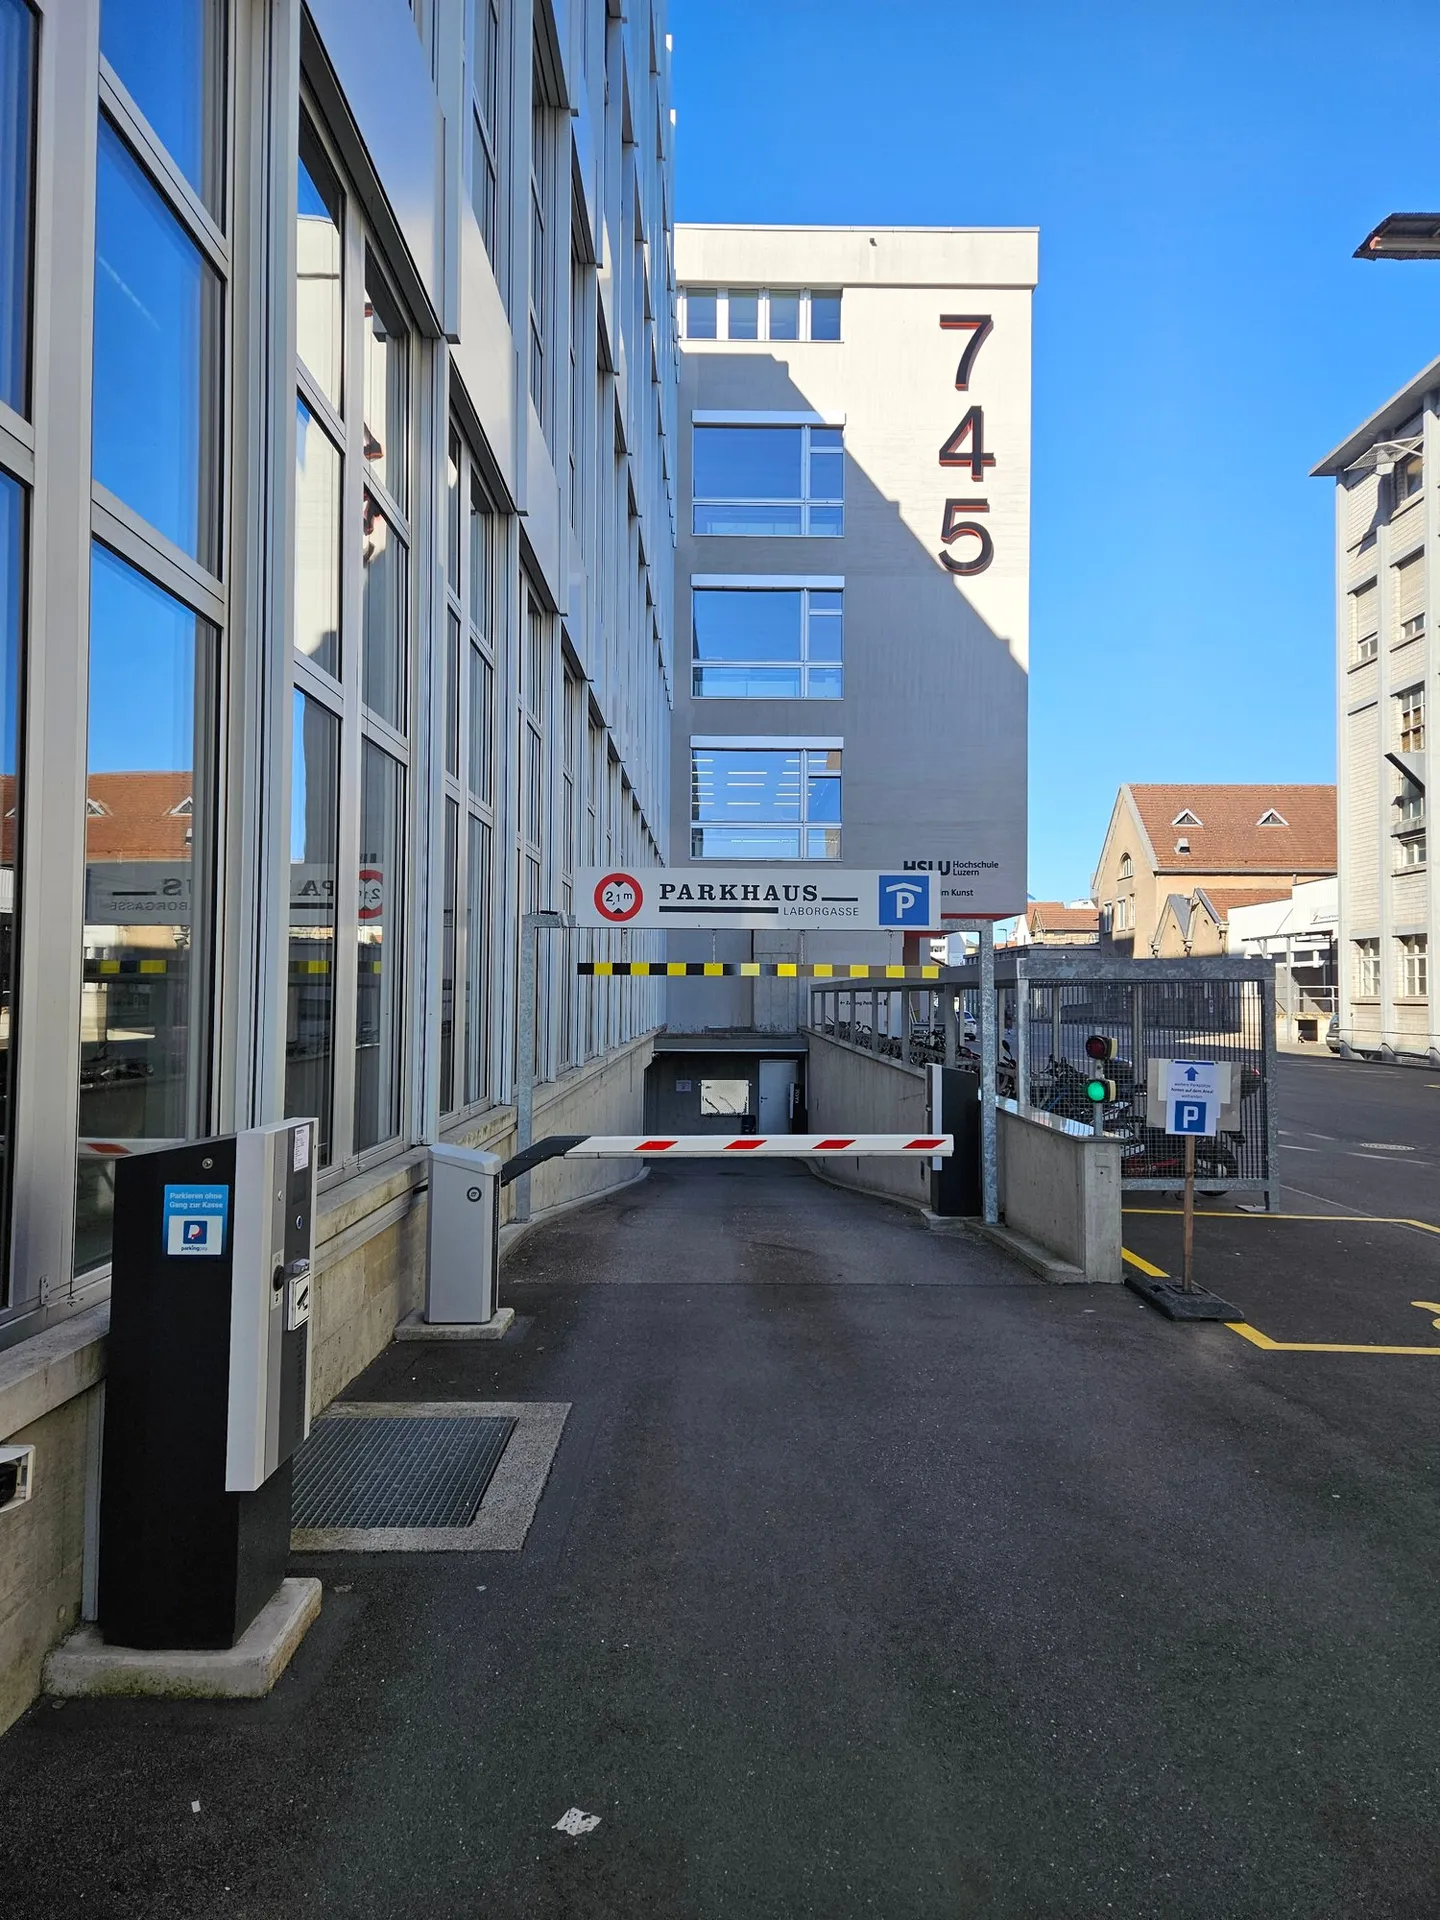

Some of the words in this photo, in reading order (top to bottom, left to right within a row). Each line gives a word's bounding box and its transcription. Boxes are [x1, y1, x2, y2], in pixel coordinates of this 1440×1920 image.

[952, 860, 999, 869] Hochschule
[659, 883, 818, 902] PARKHAUS
[951, 889, 974, 897] Kunst
[783, 907, 859, 916] LABORGASSE
[169, 1201, 188, 1209] Gang
